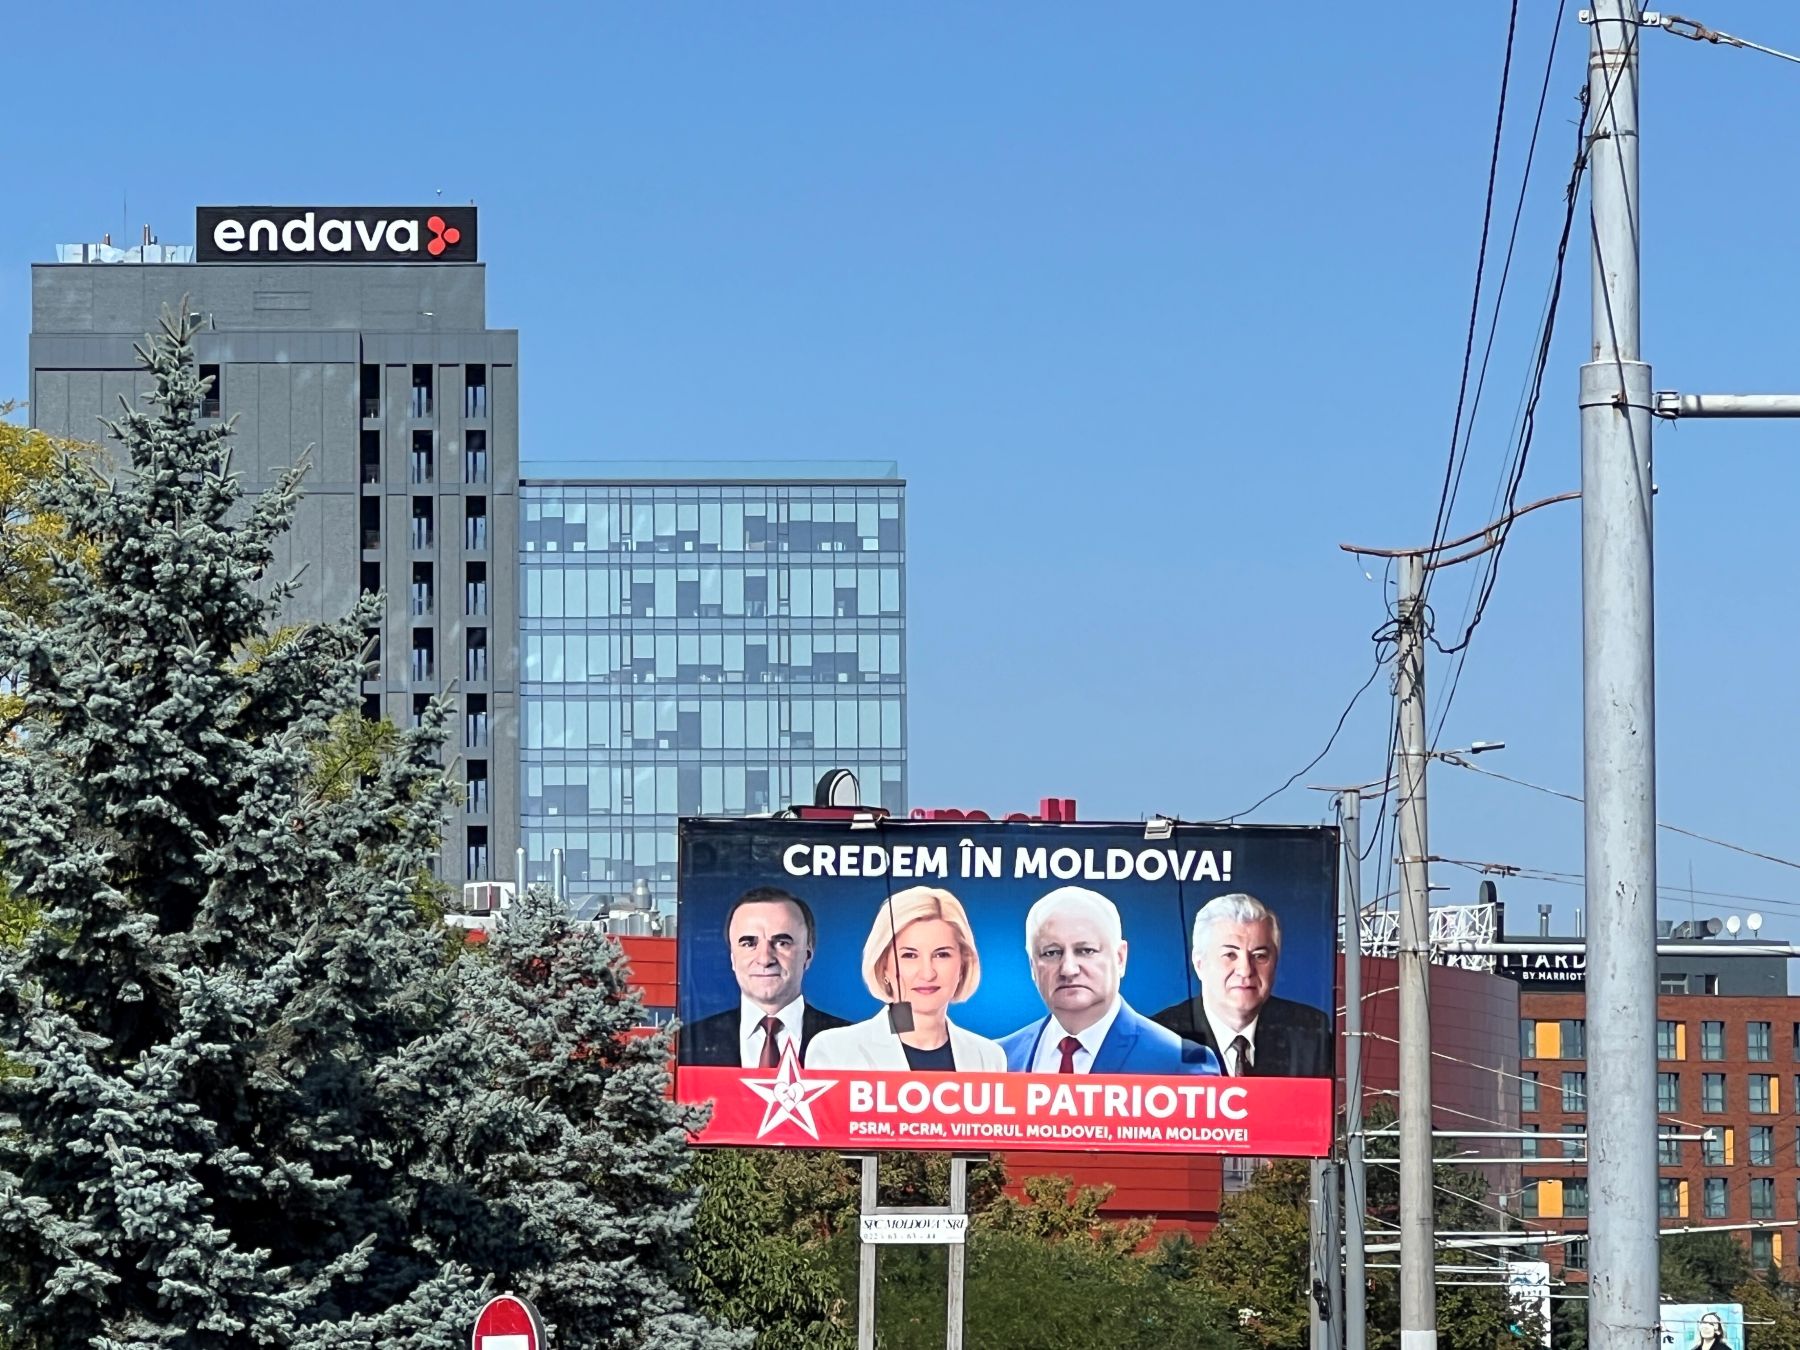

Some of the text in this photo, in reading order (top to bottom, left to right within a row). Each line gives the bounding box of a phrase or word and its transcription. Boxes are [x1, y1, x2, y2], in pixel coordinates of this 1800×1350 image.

[213, 212, 420, 252] endava
[783, 838, 1232, 882] CREDEM ÎN MOLDOVA!
[1522, 971, 1586, 981] BY MARRIOT
[849, 1080, 1249, 1120] BLOCUL PATRIOTIC
[849, 1121, 1248, 1142] PSRM, PCRM, VIITORUL MOLDOVEI, INIMA MOLDOVEI
